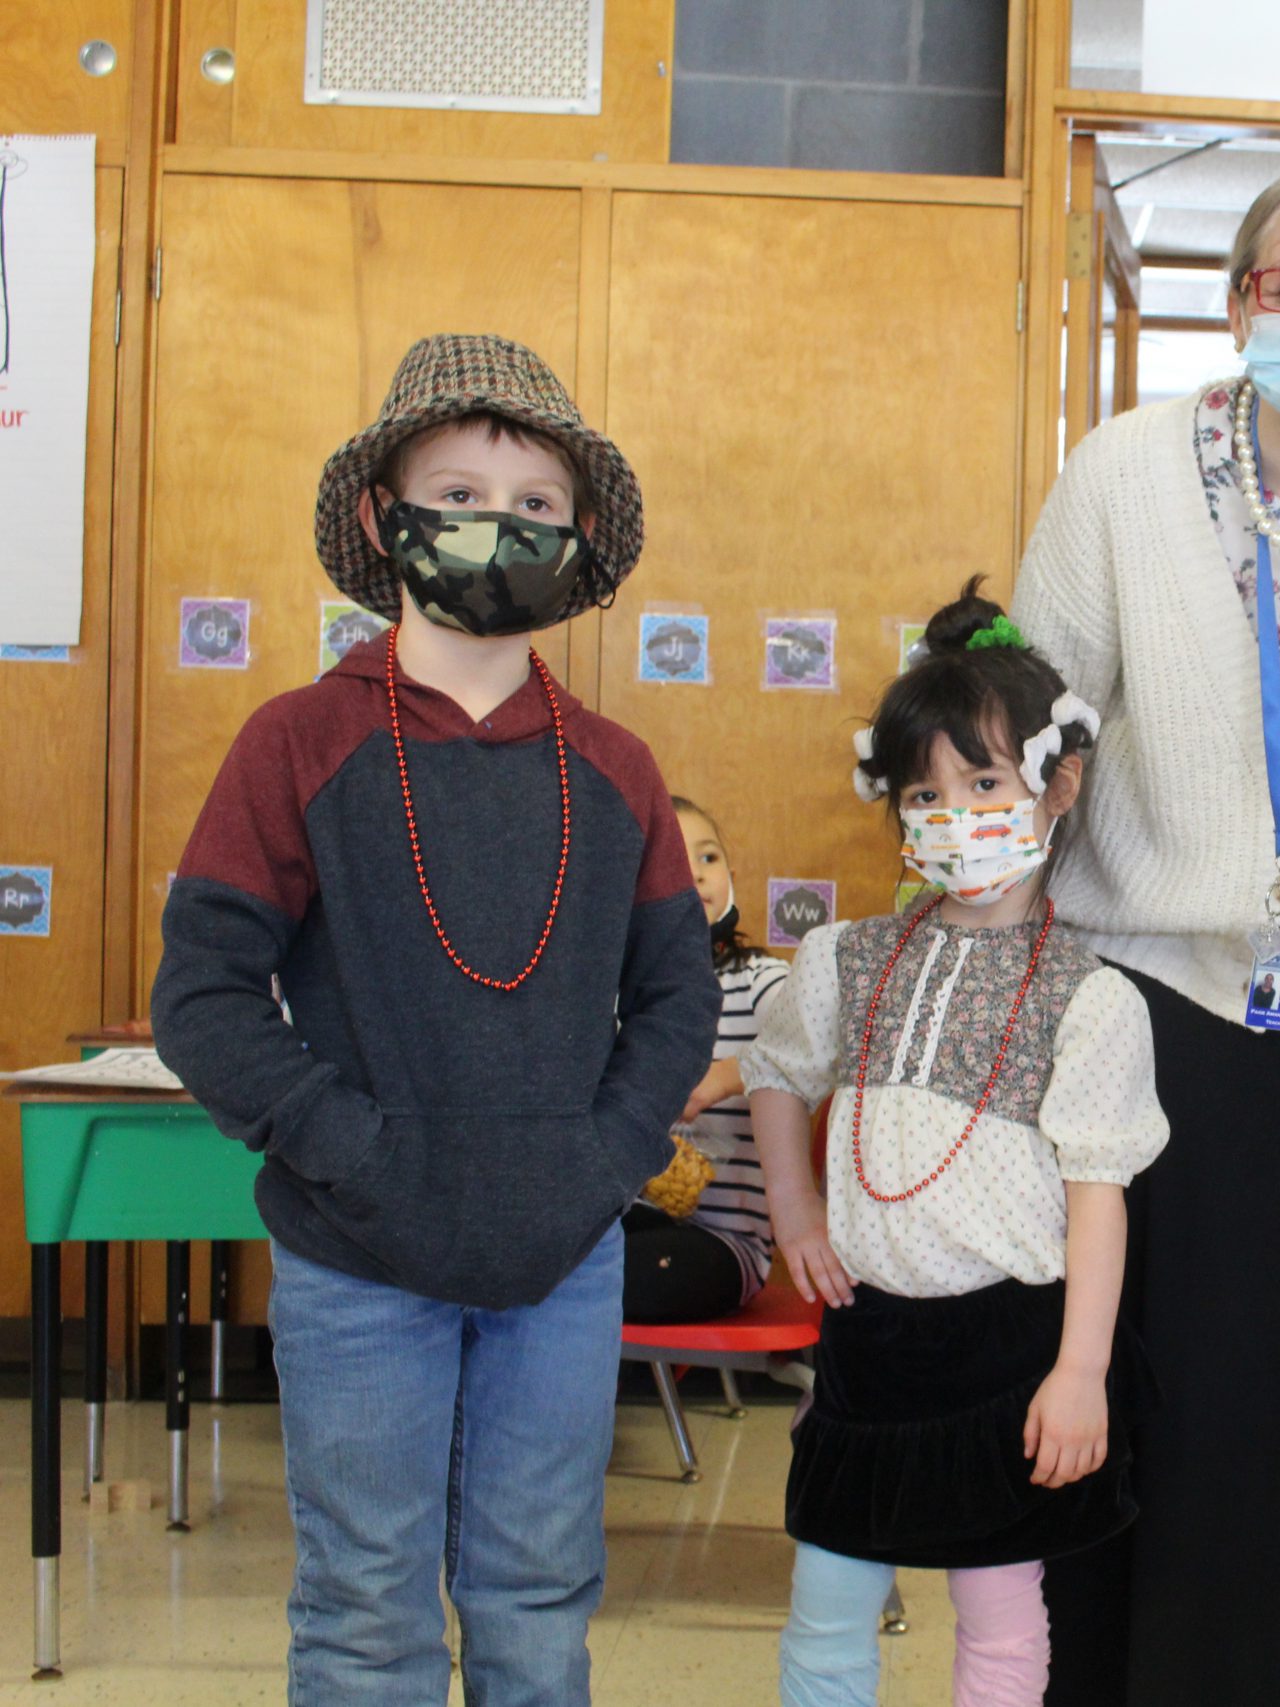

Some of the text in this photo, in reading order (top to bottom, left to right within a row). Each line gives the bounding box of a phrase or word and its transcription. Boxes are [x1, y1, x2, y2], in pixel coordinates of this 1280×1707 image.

[201, 621, 229, 649] Gg
[4, 887, 30, 910] Rr
[782, 902, 820, 922] Ww
